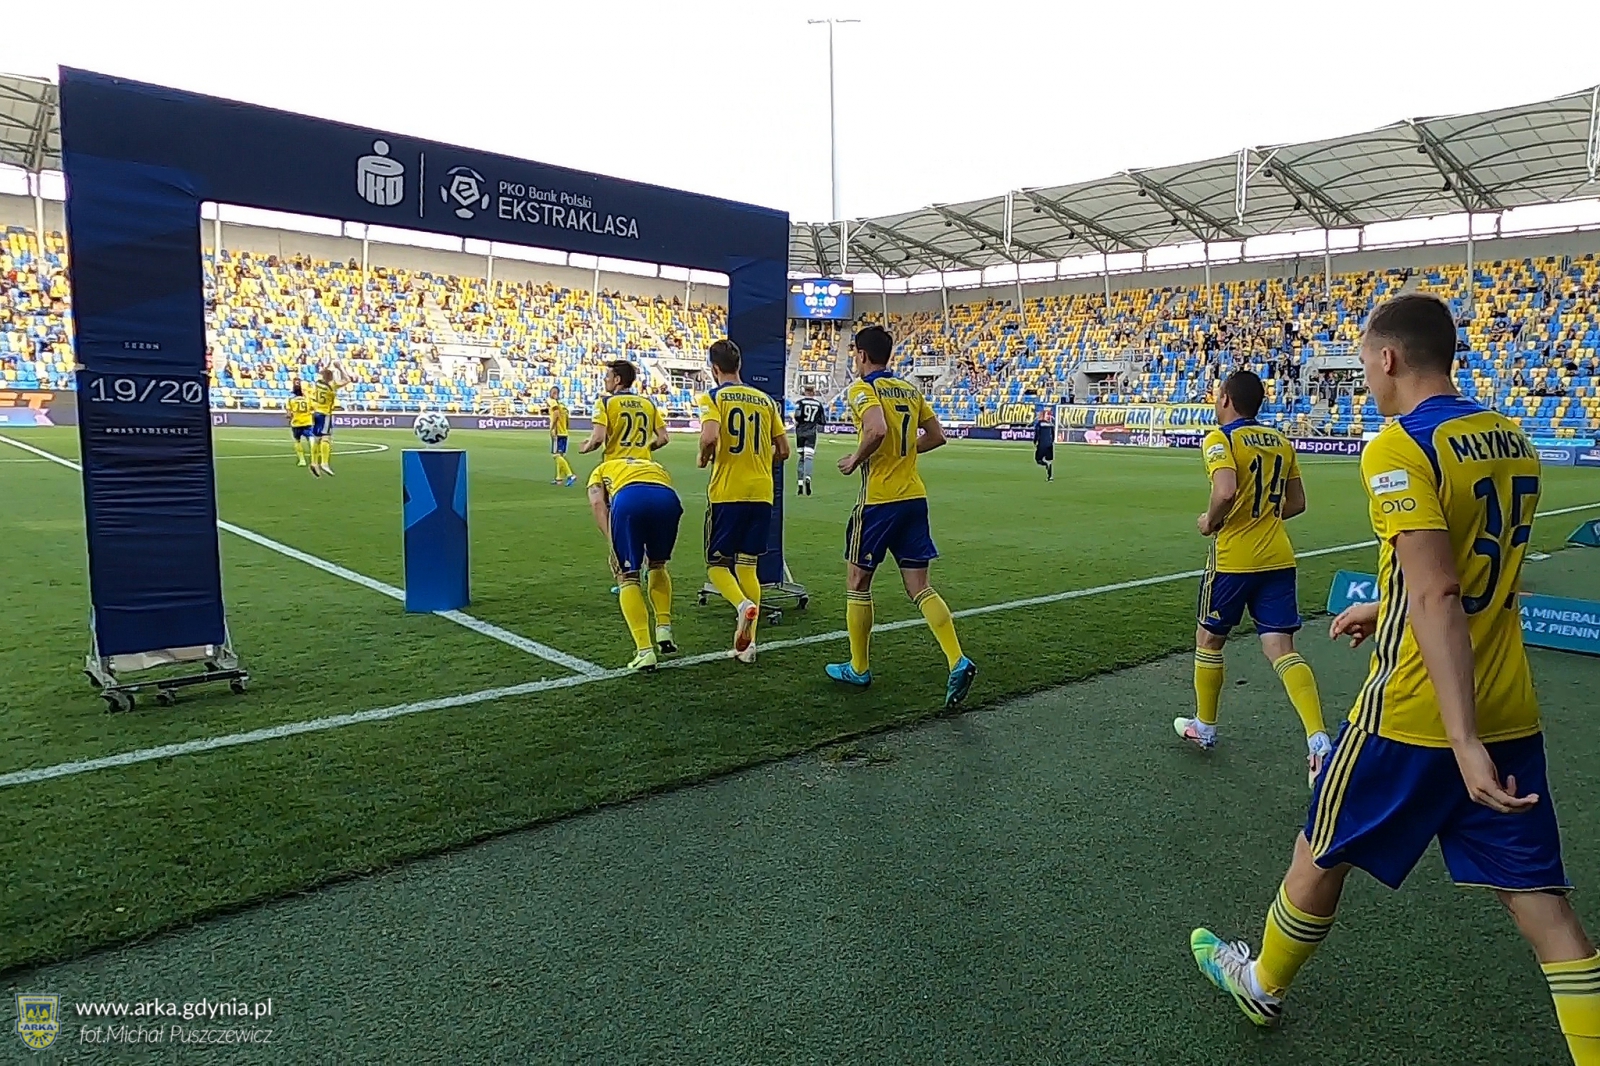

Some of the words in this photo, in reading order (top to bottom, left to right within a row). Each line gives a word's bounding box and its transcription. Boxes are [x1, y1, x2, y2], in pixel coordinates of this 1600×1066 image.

[499, 181, 525, 197] PKO
[529, 187, 557, 202] Bank
[560, 193, 592, 209] Polski
[499, 197, 639, 239] EKSTRAKLASA
[90, 378, 203, 403] 19/20
[620, 412, 648, 447] 23
[727, 407, 760, 455] 91
[804, 405, 818, 422] 97
[895, 405, 911, 457] 7
[1250, 454, 1285, 518] 14
[1535, 622, 1545, 632] Z
